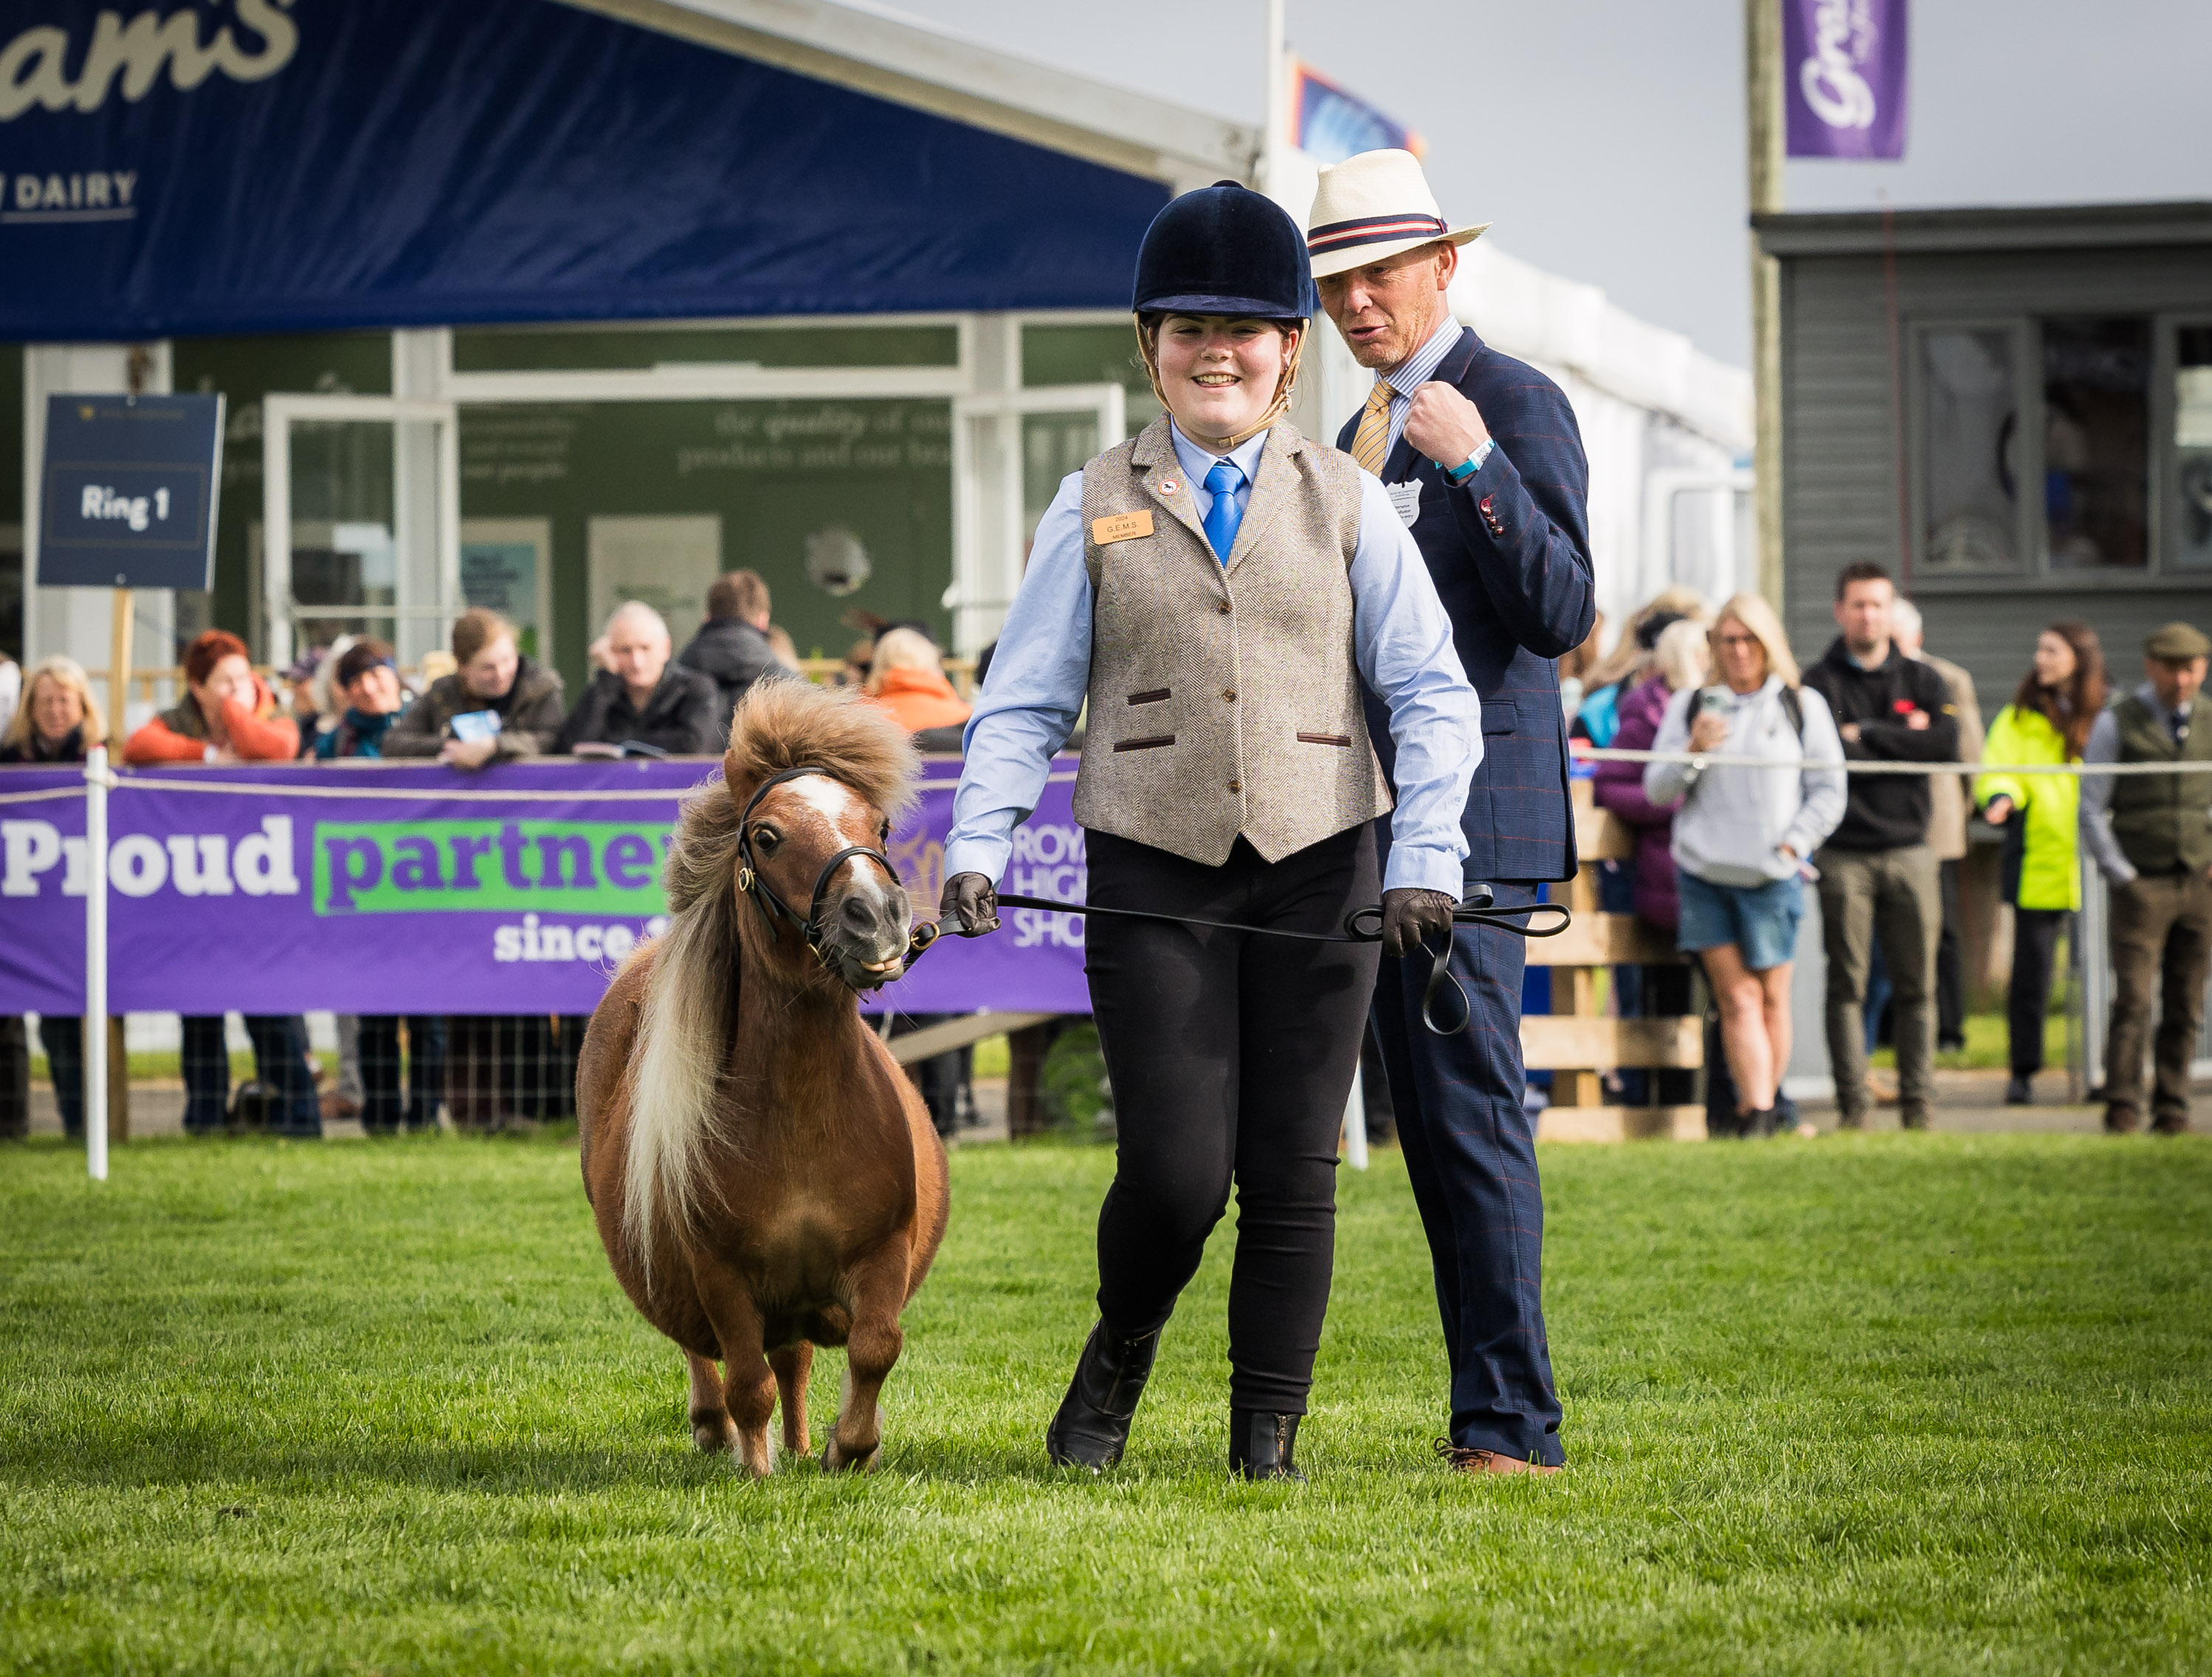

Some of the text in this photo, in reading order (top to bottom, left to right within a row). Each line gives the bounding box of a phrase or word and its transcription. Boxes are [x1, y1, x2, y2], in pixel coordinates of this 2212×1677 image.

[15, 171, 139, 210] DAIRY
[81, 484, 170, 532] Ring 1
[1106, 521, 1140, 533] G.E.M.S.
[1112, 531, 1137, 540] MEMBER
[324, 816, 671, 911] partne
[493, 913, 634, 963] since
